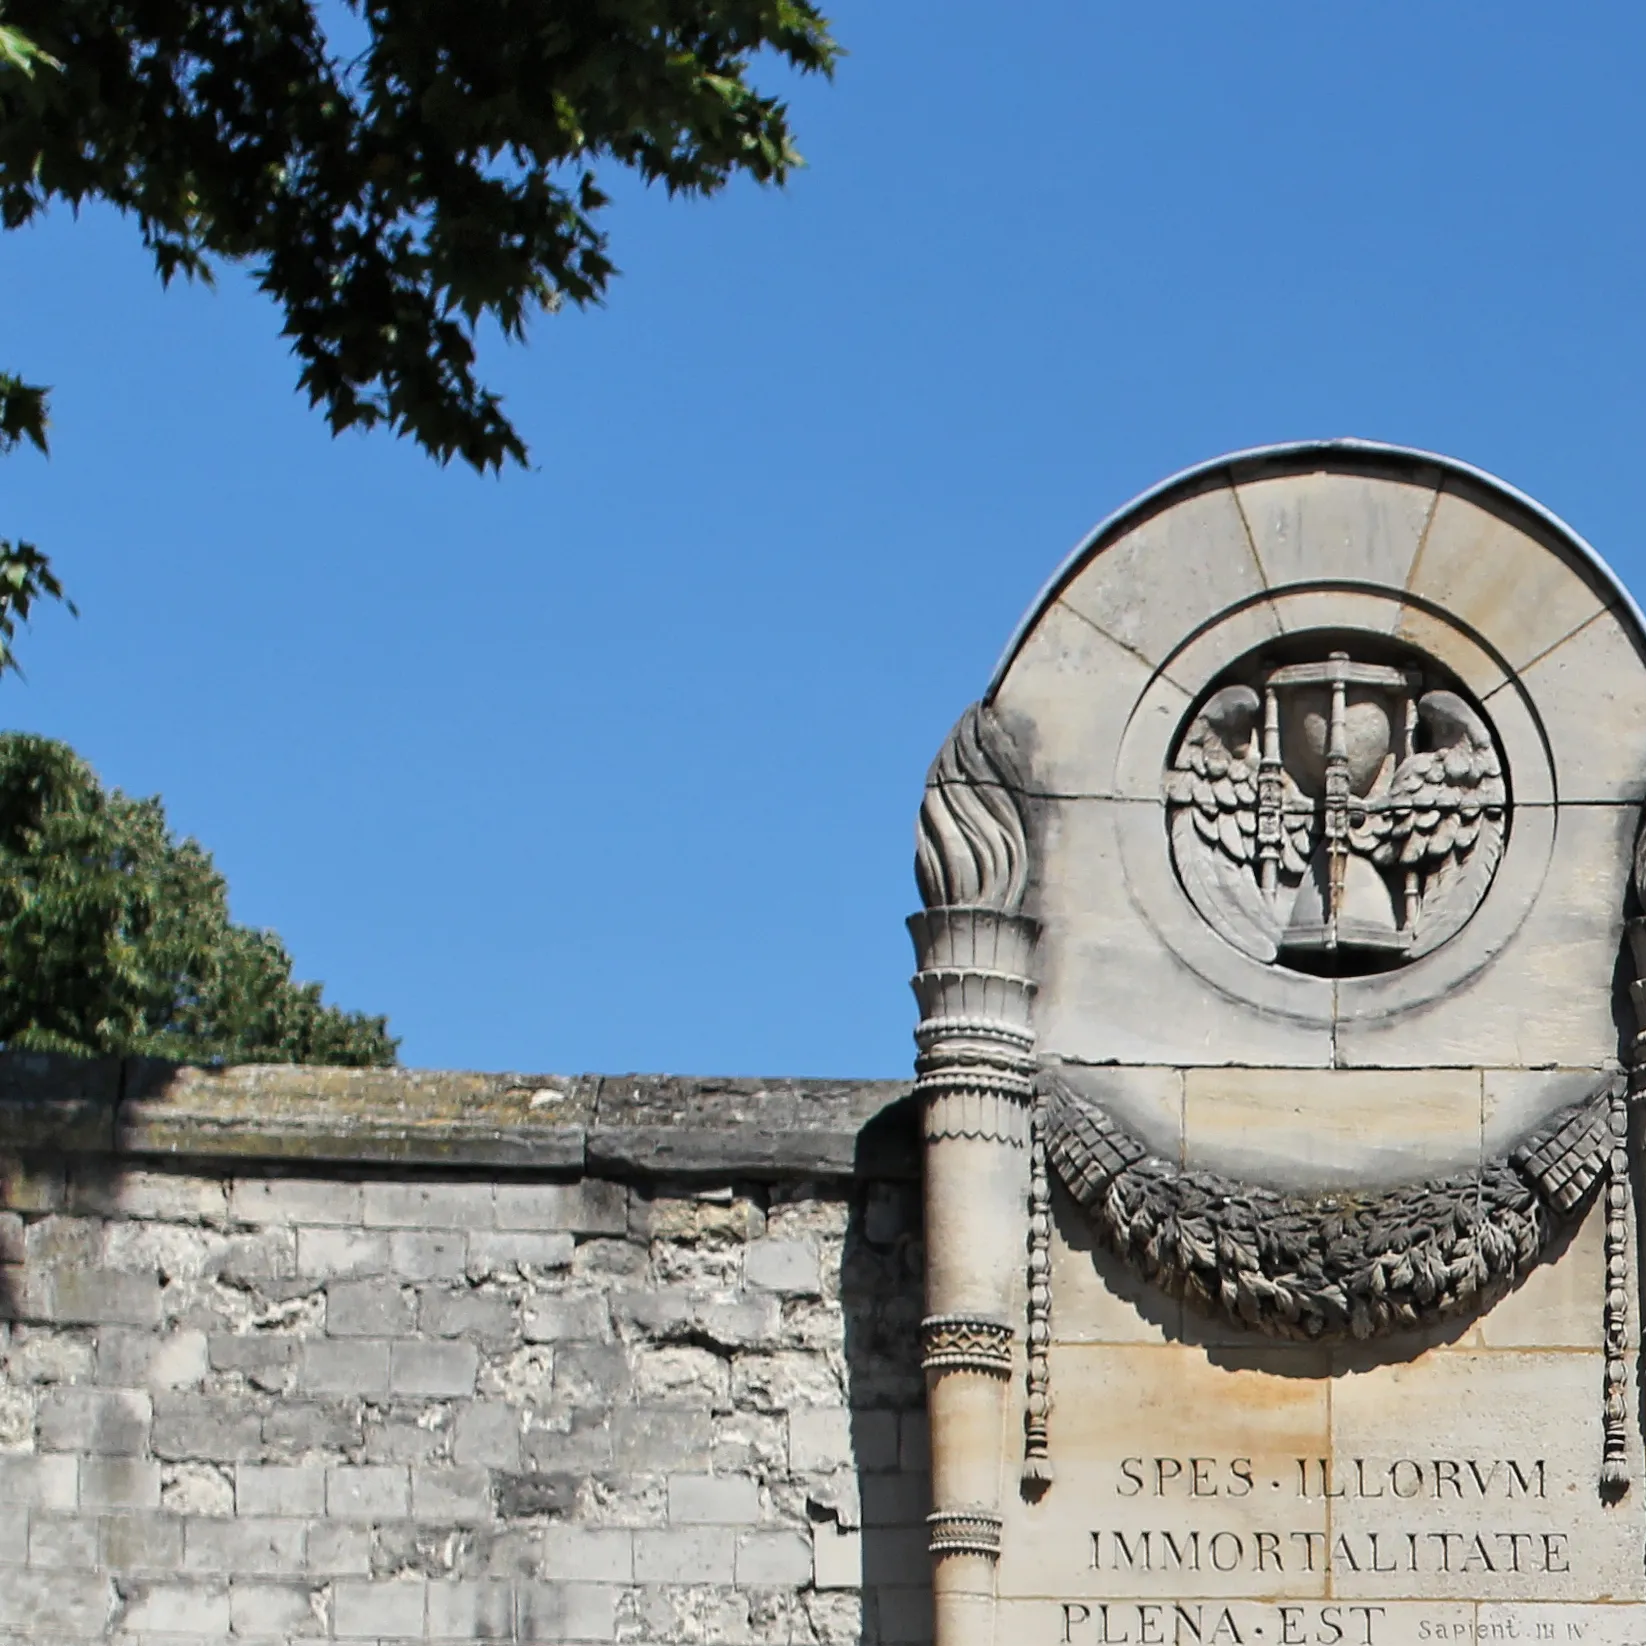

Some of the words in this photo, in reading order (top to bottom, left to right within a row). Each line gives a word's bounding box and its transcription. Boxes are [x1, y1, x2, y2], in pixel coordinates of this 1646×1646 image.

[1116, 1457, 1254, 1498] SPES
[1295, 1458, 1547, 1499] ILLORVM
[1086, 1530, 1571, 1573] IMMORTALITATE
[1059, 1603, 1245, 1646] PLENA
[1276, 1606, 1387, 1646] EST
